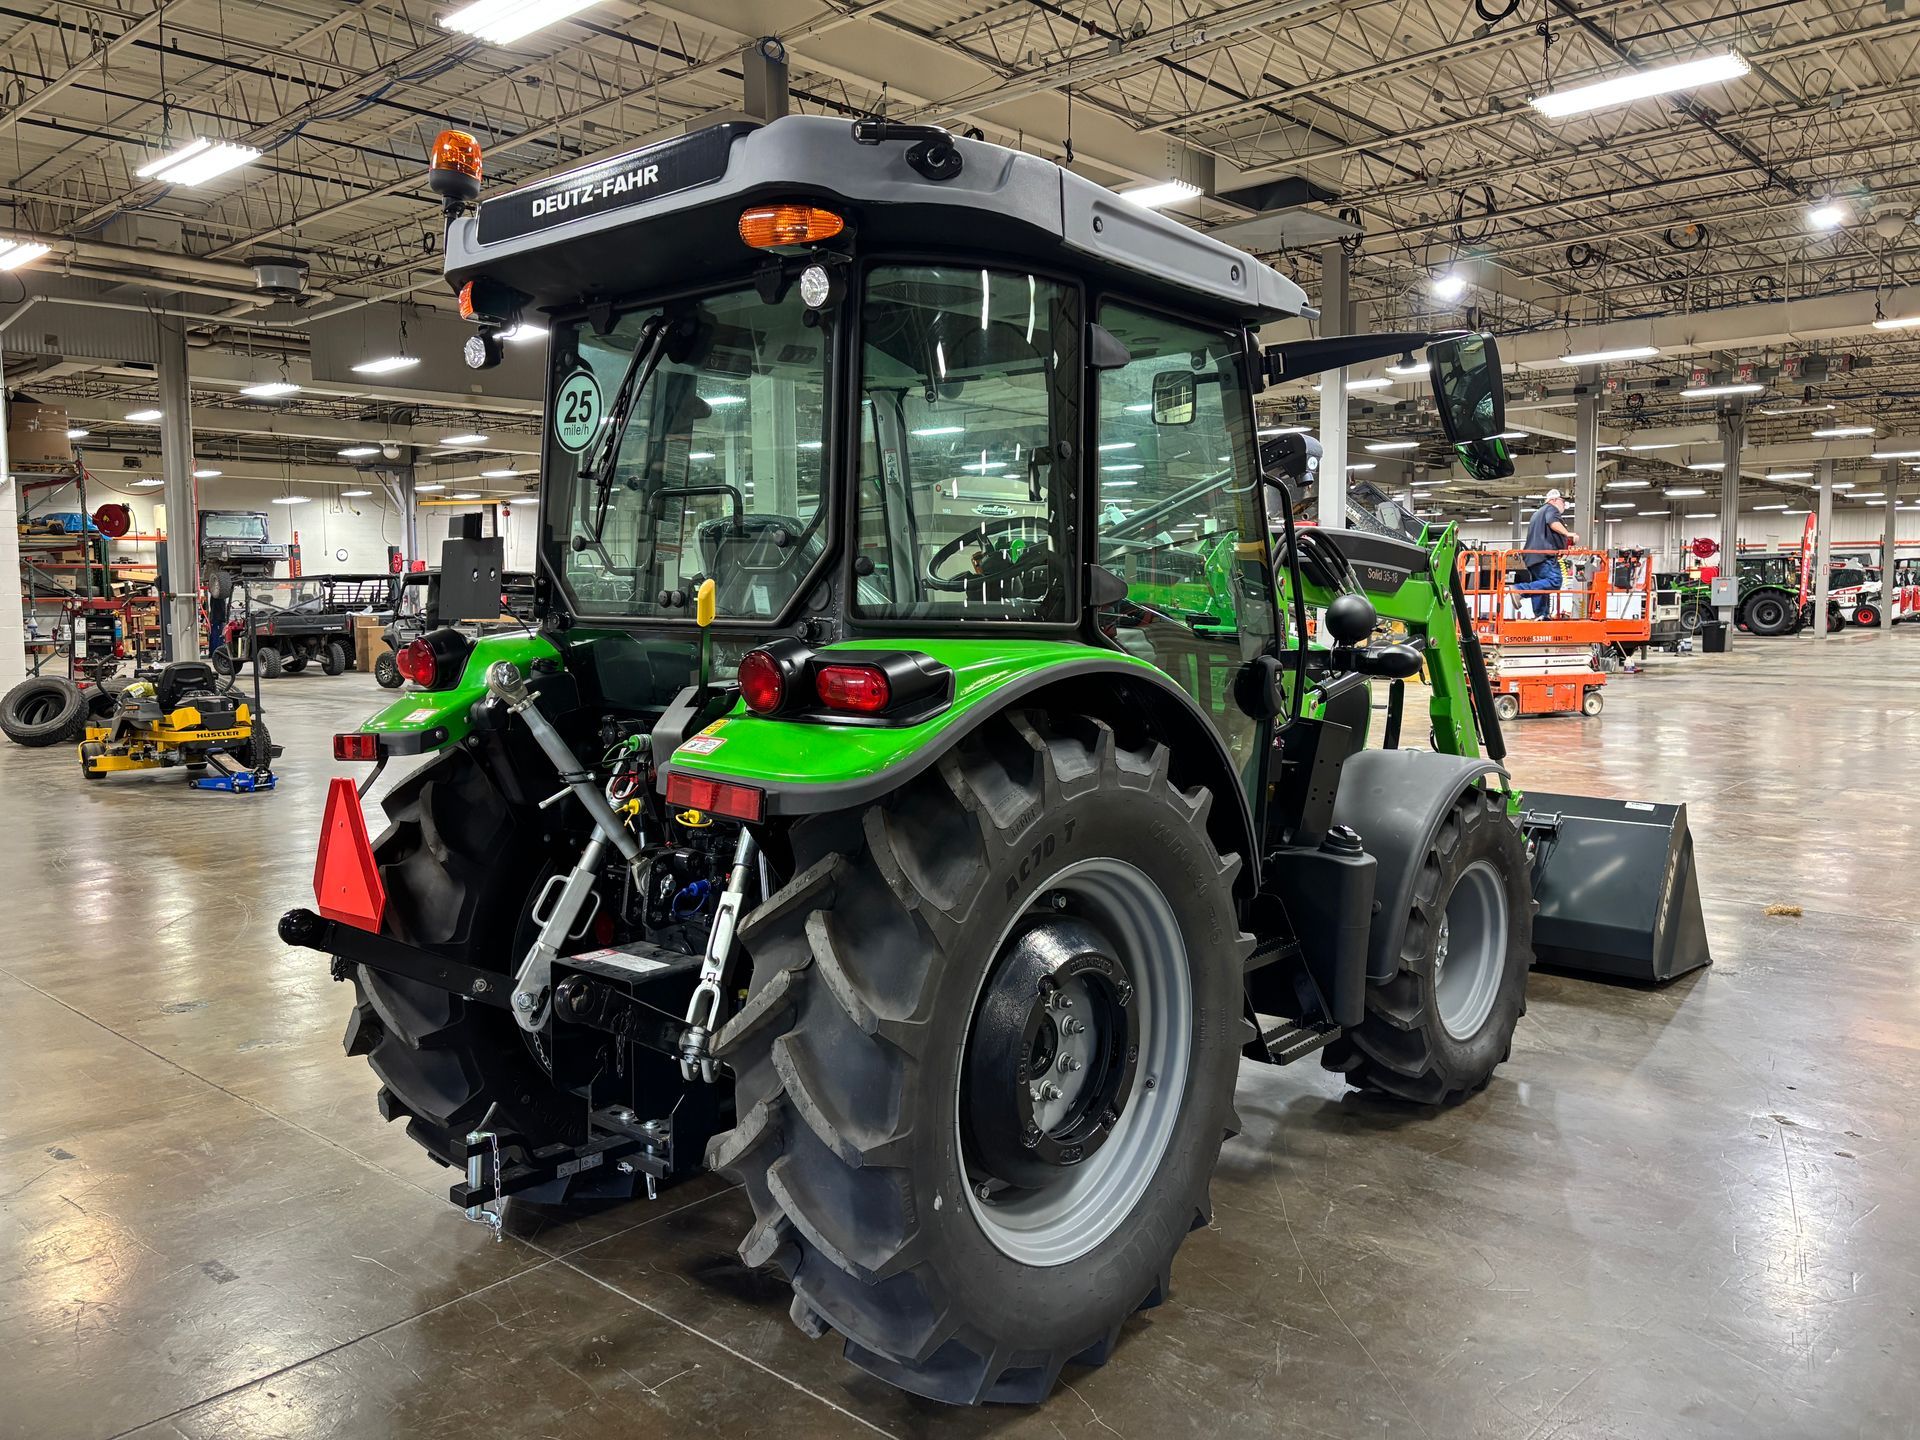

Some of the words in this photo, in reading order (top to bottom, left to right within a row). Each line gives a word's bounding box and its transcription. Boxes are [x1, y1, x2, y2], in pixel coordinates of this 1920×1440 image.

[532, 164, 659, 217] DEUTZ-FAHR
[1783, 362, 1797, 372] 107
[1692, 373, 1705, 382] 103
[1738, 368, 1751, 378] 105
[564, 390, 592, 423] 25
[563, 424, 590, 436] mile/h
[1367, 567, 1383, 581] Solid
[196, 730, 240, 739] HUSTLER
